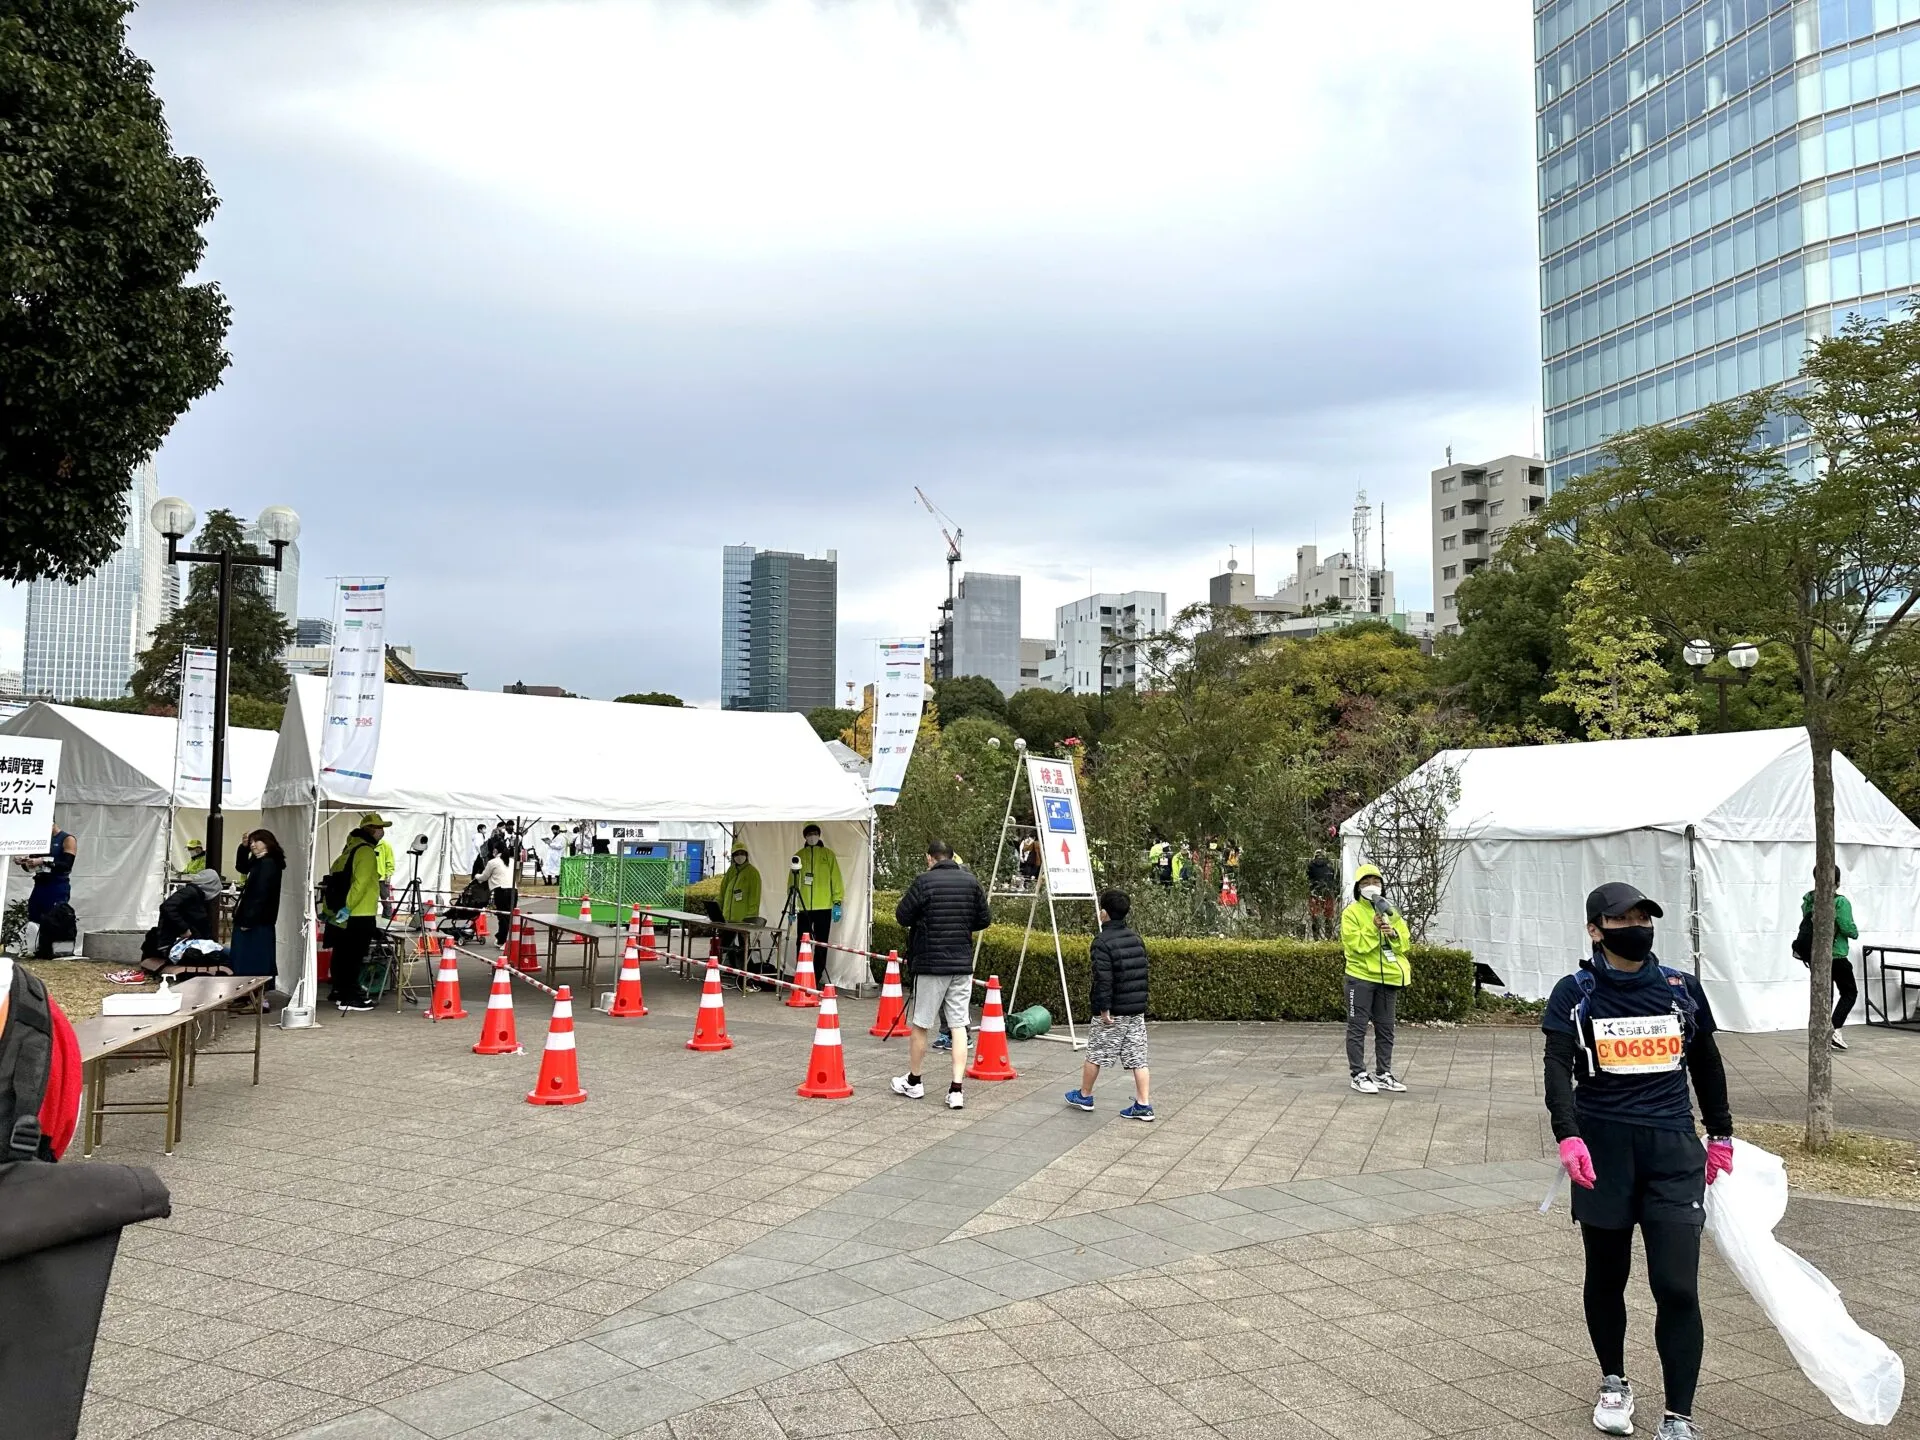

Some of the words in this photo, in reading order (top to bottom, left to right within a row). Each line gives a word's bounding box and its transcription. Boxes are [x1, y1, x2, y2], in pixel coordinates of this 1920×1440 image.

[1040, 767, 1064, 786] 検温
[0, 797, 34, 814] 記入台
[626, 828, 644, 838] 検温
[1618, 1024, 1668, 1036] きらぼし銀行
[1614, 1037, 1680, 1058] 06850
